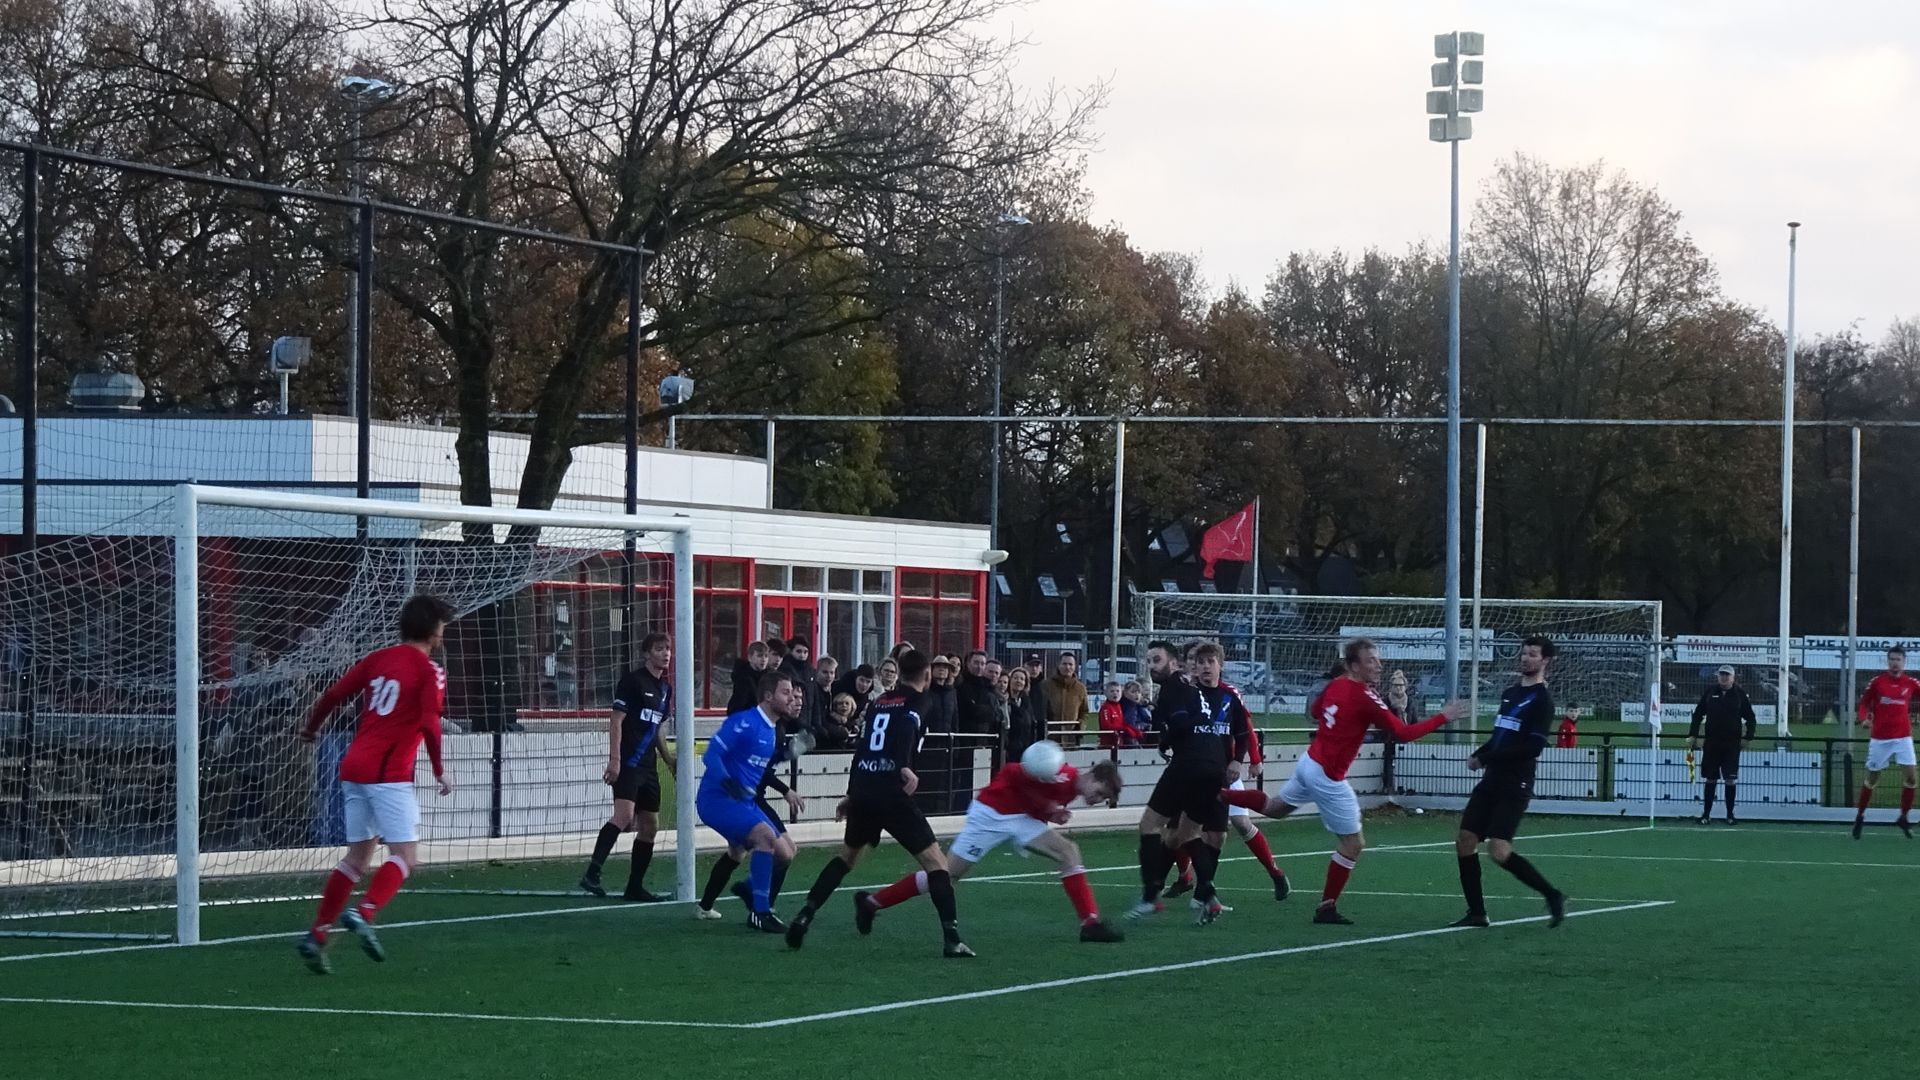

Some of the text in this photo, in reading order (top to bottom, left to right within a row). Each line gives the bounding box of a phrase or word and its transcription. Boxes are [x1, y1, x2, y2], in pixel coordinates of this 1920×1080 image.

[1573, 633, 1645, 642] TIMMERMAN
[1807, 639, 1832, 648] THE
[1841, 640, 1890, 649] LVING
[369, 676, 400, 716] 10
[870, 713, 890, 751] 8
